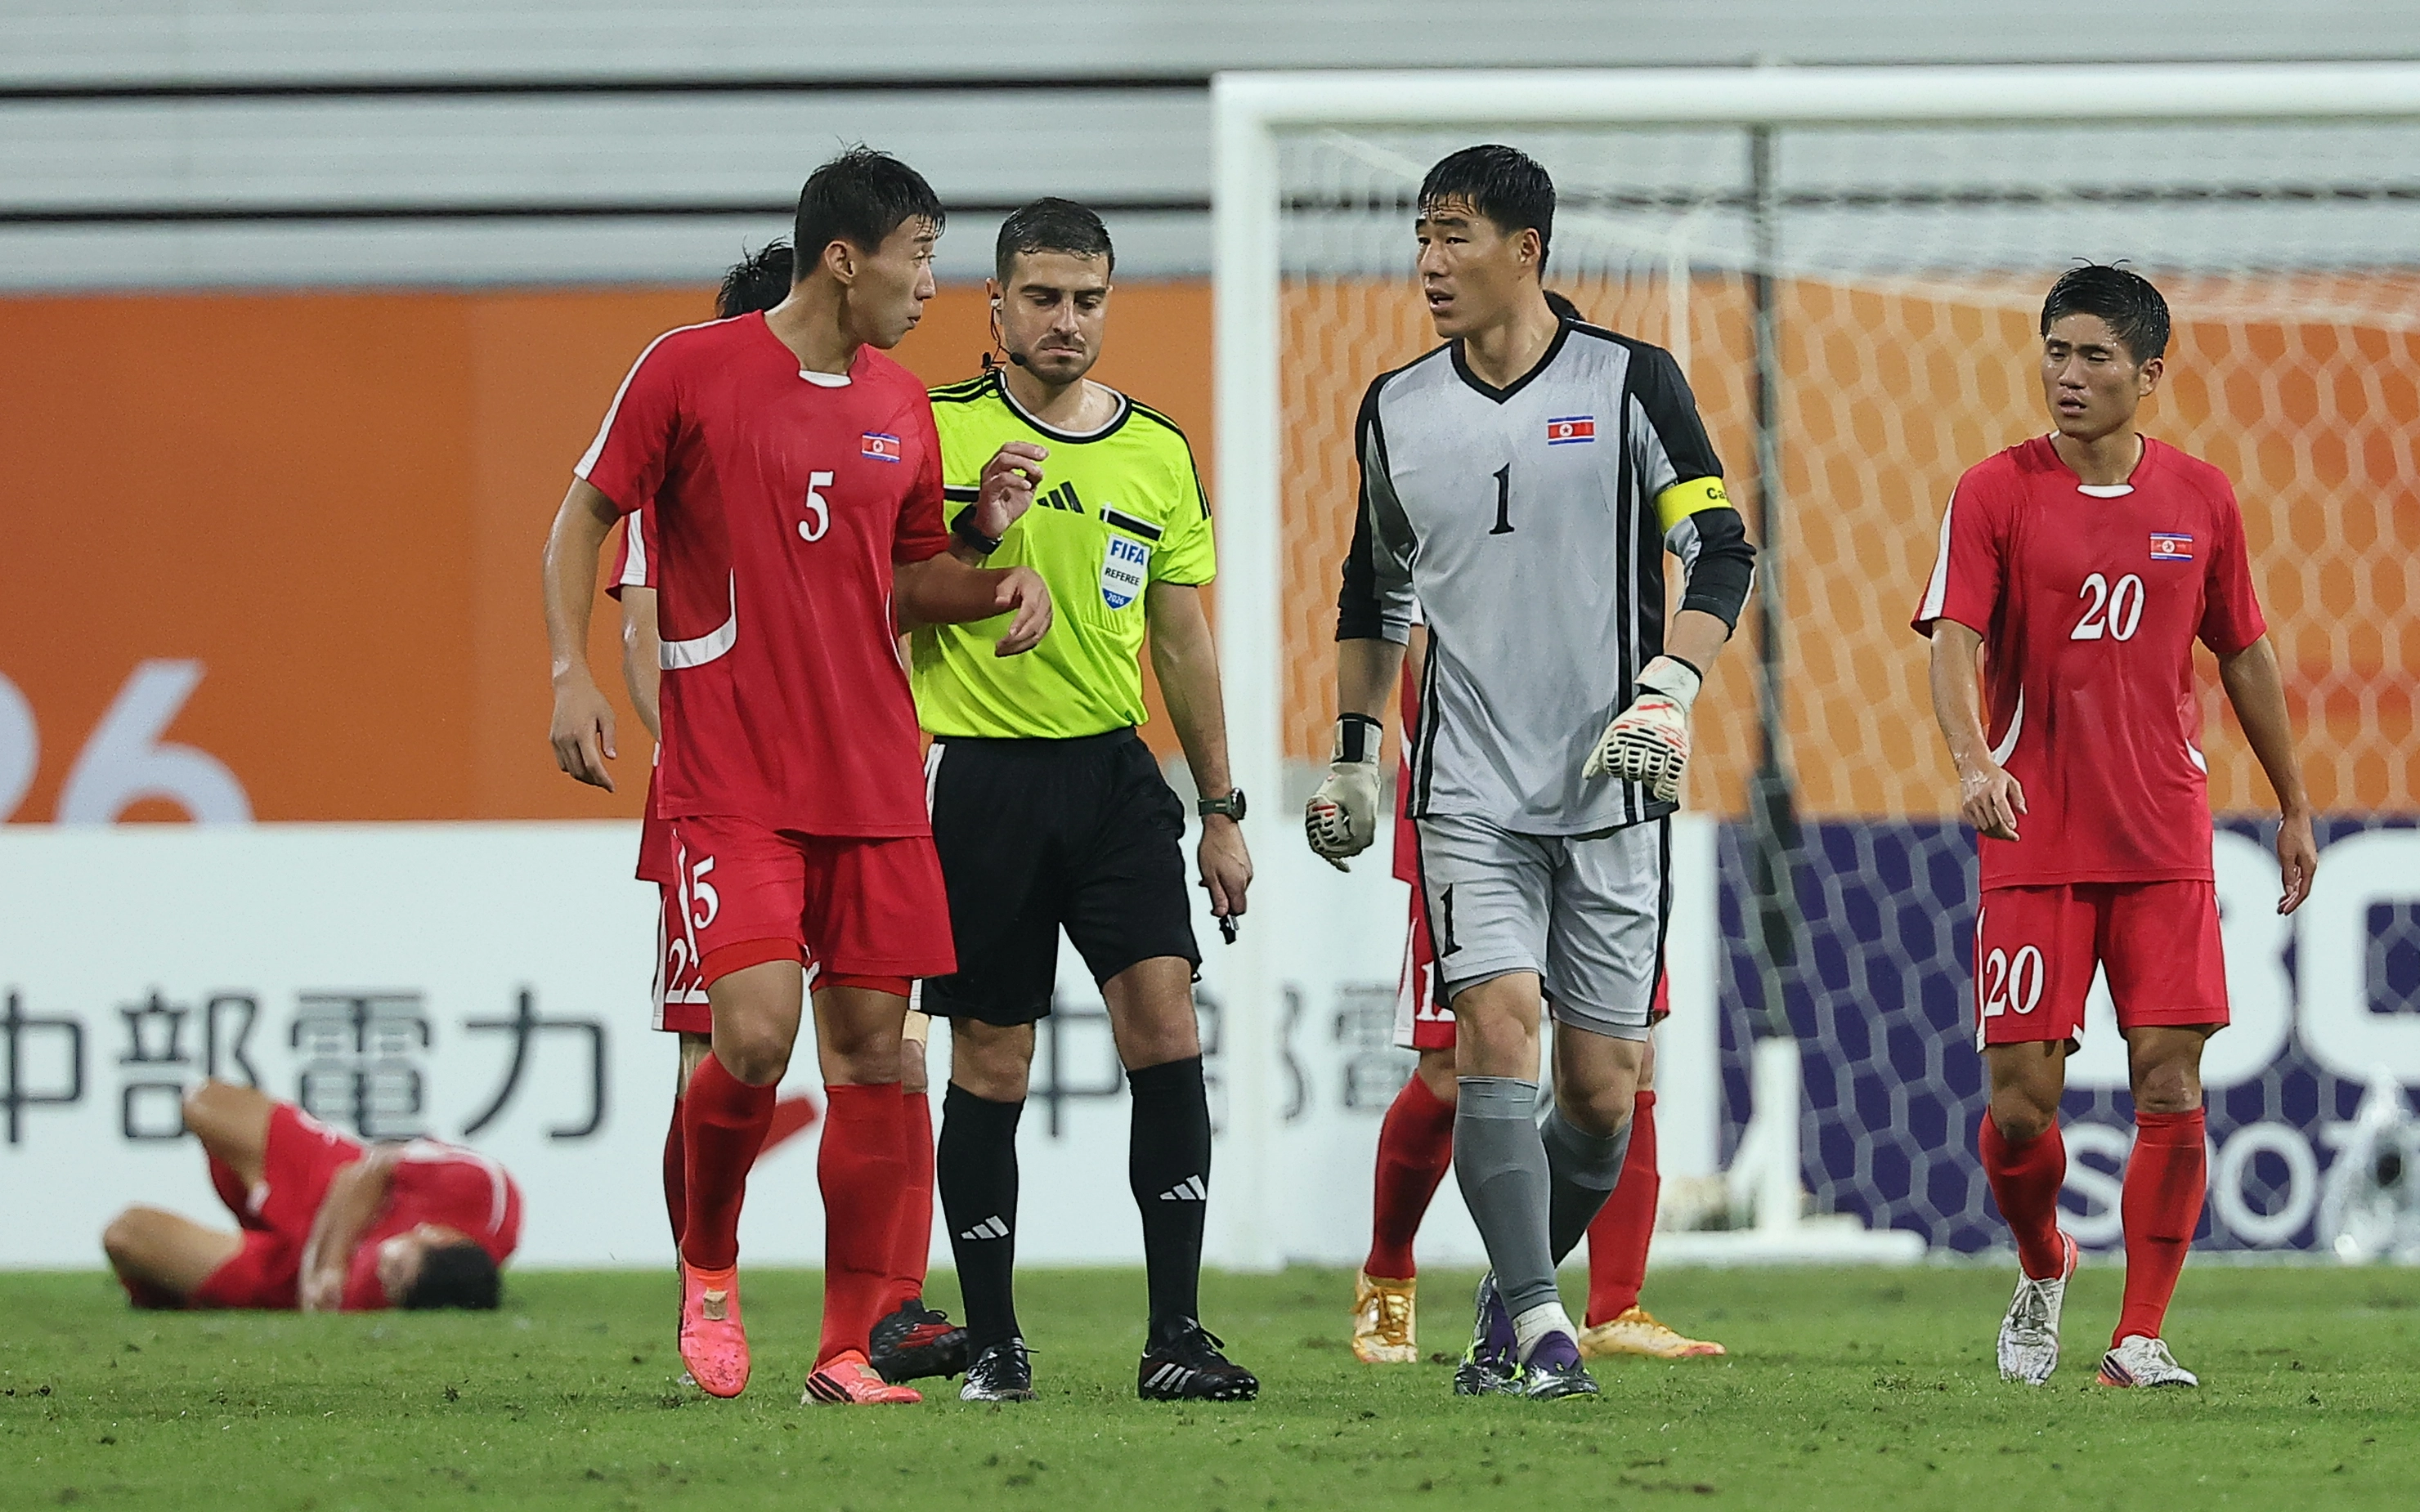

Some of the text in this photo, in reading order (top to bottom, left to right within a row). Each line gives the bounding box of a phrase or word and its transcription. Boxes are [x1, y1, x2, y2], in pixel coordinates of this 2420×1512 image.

[798, 470, 834, 542] 5
[1489, 461, 1515, 535] 1
[1105, 566, 1141, 586] REFEREE
[1110, 539, 1145, 566] FIFA
[1106, 593, 1125, 606] 2026
[2070, 572, 2145, 641] 20
[693, 855, 719, 929] 5
[1440, 883, 1463, 958] 1
[1984, 945, 2044, 1017] 20
